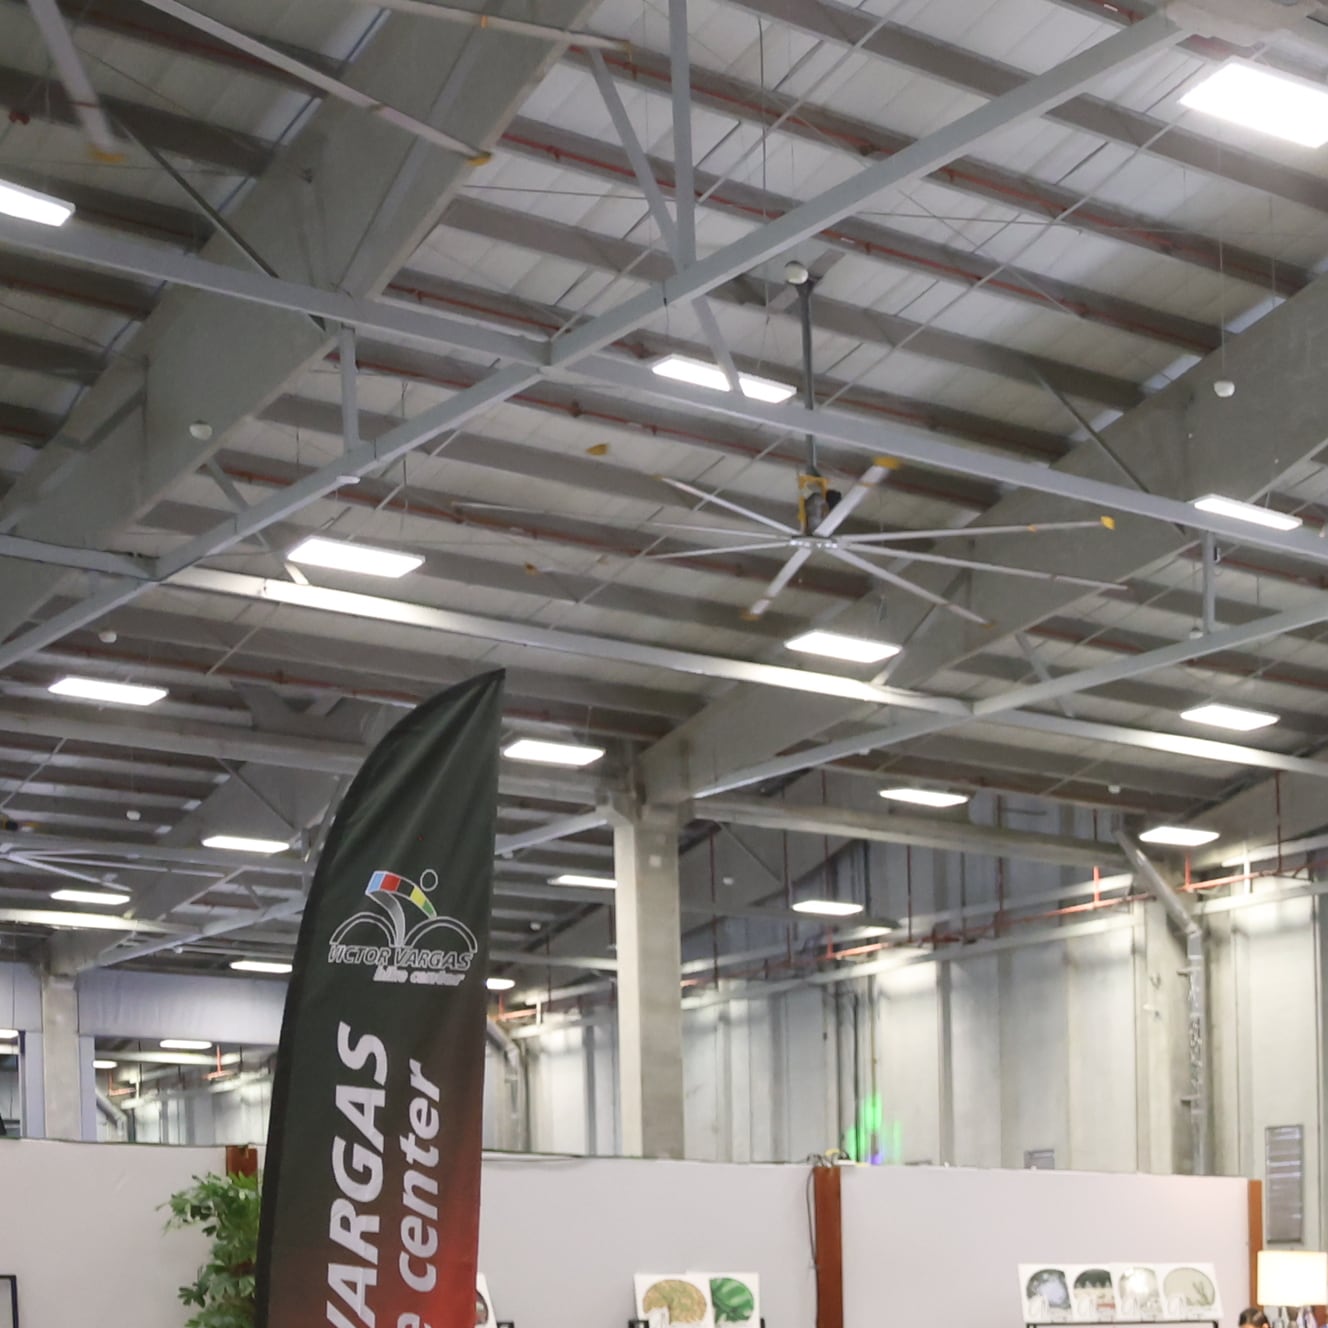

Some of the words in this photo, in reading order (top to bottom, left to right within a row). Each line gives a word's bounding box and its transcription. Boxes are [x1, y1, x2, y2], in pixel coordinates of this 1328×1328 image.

[328, 944, 391, 966] VICTOR
[395, 946, 475, 971] VARGAS
[399, 1058, 441, 1293] center
